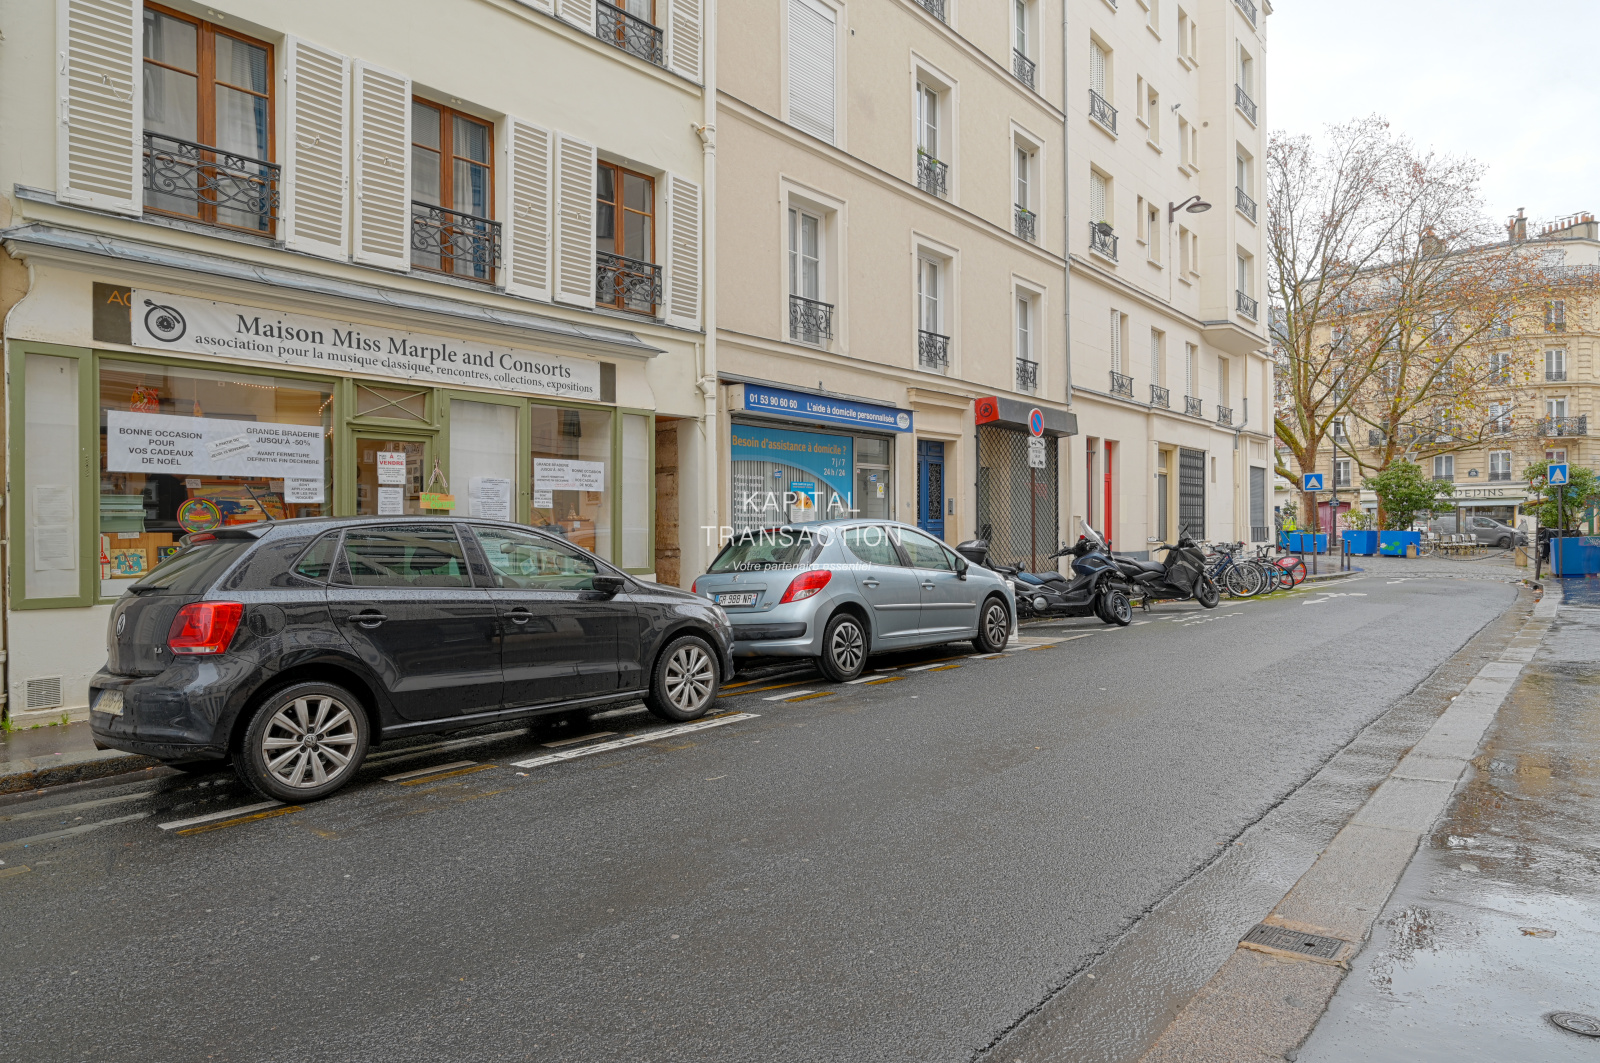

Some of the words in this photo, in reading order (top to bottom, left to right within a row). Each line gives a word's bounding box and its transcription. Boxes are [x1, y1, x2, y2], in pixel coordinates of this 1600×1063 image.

[235, 313, 324, 345] Maison
[332, 328, 381, 353] Miss
[387, 337, 457, 365] Marple
[462, 351, 495, 368] and
[499, 353, 571, 378] Consorts
[195, 335, 273, 353] association
[278, 344, 309, 357] pour
[313, 347, 324, 359] la
[327, 351, 378, 367] musique
[381, 356, 434, 374] classique,
[436, 366, 492, 382] rencontres,
[493, 372, 545, 388] collections,
[546, 379, 593, 394] expositions
[749, 393, 758, 403] 01
[760, 394, 768, 404] 53
[770, 396, 779, 406] 90
[779, 398, 788, 407] 60
[789, 399, 797, 409] 60
[807, 402, 825, 414] L'aide
[827, 404, 831, 414] à
[832, 405, 857, 418] domicile
[857, 411, 895, 424] personnalisée
[119, 427, 152, 437] BONNE
[155, 430, 202, 439] OCCASION
[246, 427, 280, 436] GRANDE
[281, 430, 320, 438] BRADERIE
[148, 439, 175, 447] POUR
[256, 437, 291, 445] JUSQU'À
[732, 434, 759, 448] Besoin
[761, 437, 806, 453] d'assistance
[807, 443, 813, 453] à
[813, 443, 841, 455] domicile
[128, 447, 147, 455] VOS
[150, 448, 193, 457] CADEAUX
[141, 457, 154, 465] DE
[157, 457, 182, 465] NOËL
